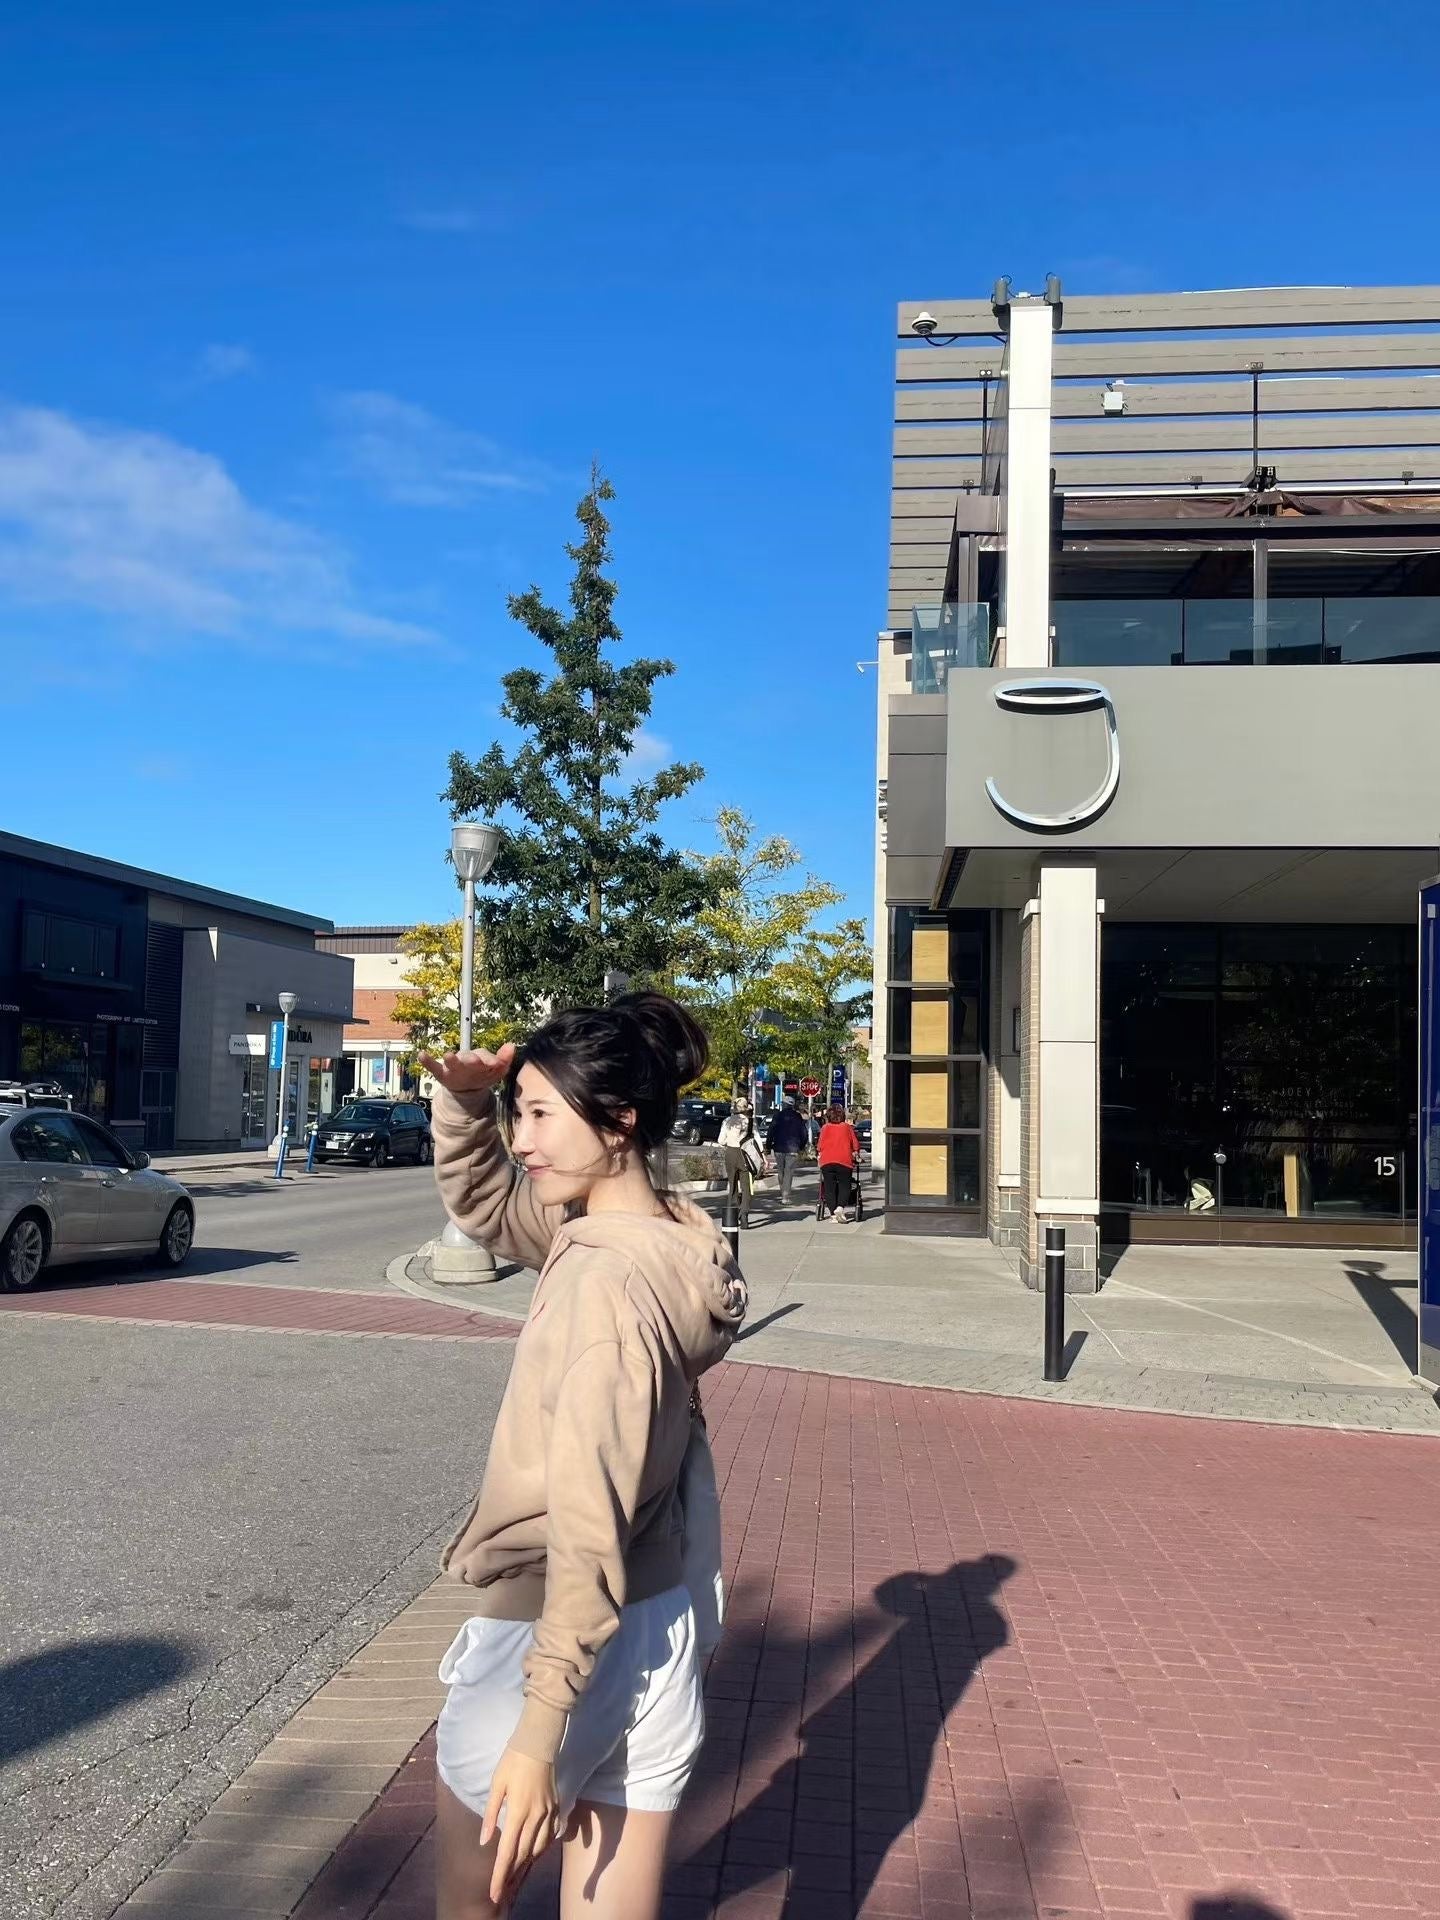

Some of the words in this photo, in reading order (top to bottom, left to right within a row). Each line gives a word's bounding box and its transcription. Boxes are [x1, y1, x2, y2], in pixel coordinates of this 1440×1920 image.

[833, 1070, 842, 1081] P
[801, 1082, 819, 1091] STOP
[1280, 1087, 1312, 1097] JOEY
[1374, 1156, 1396, 1177] 15
